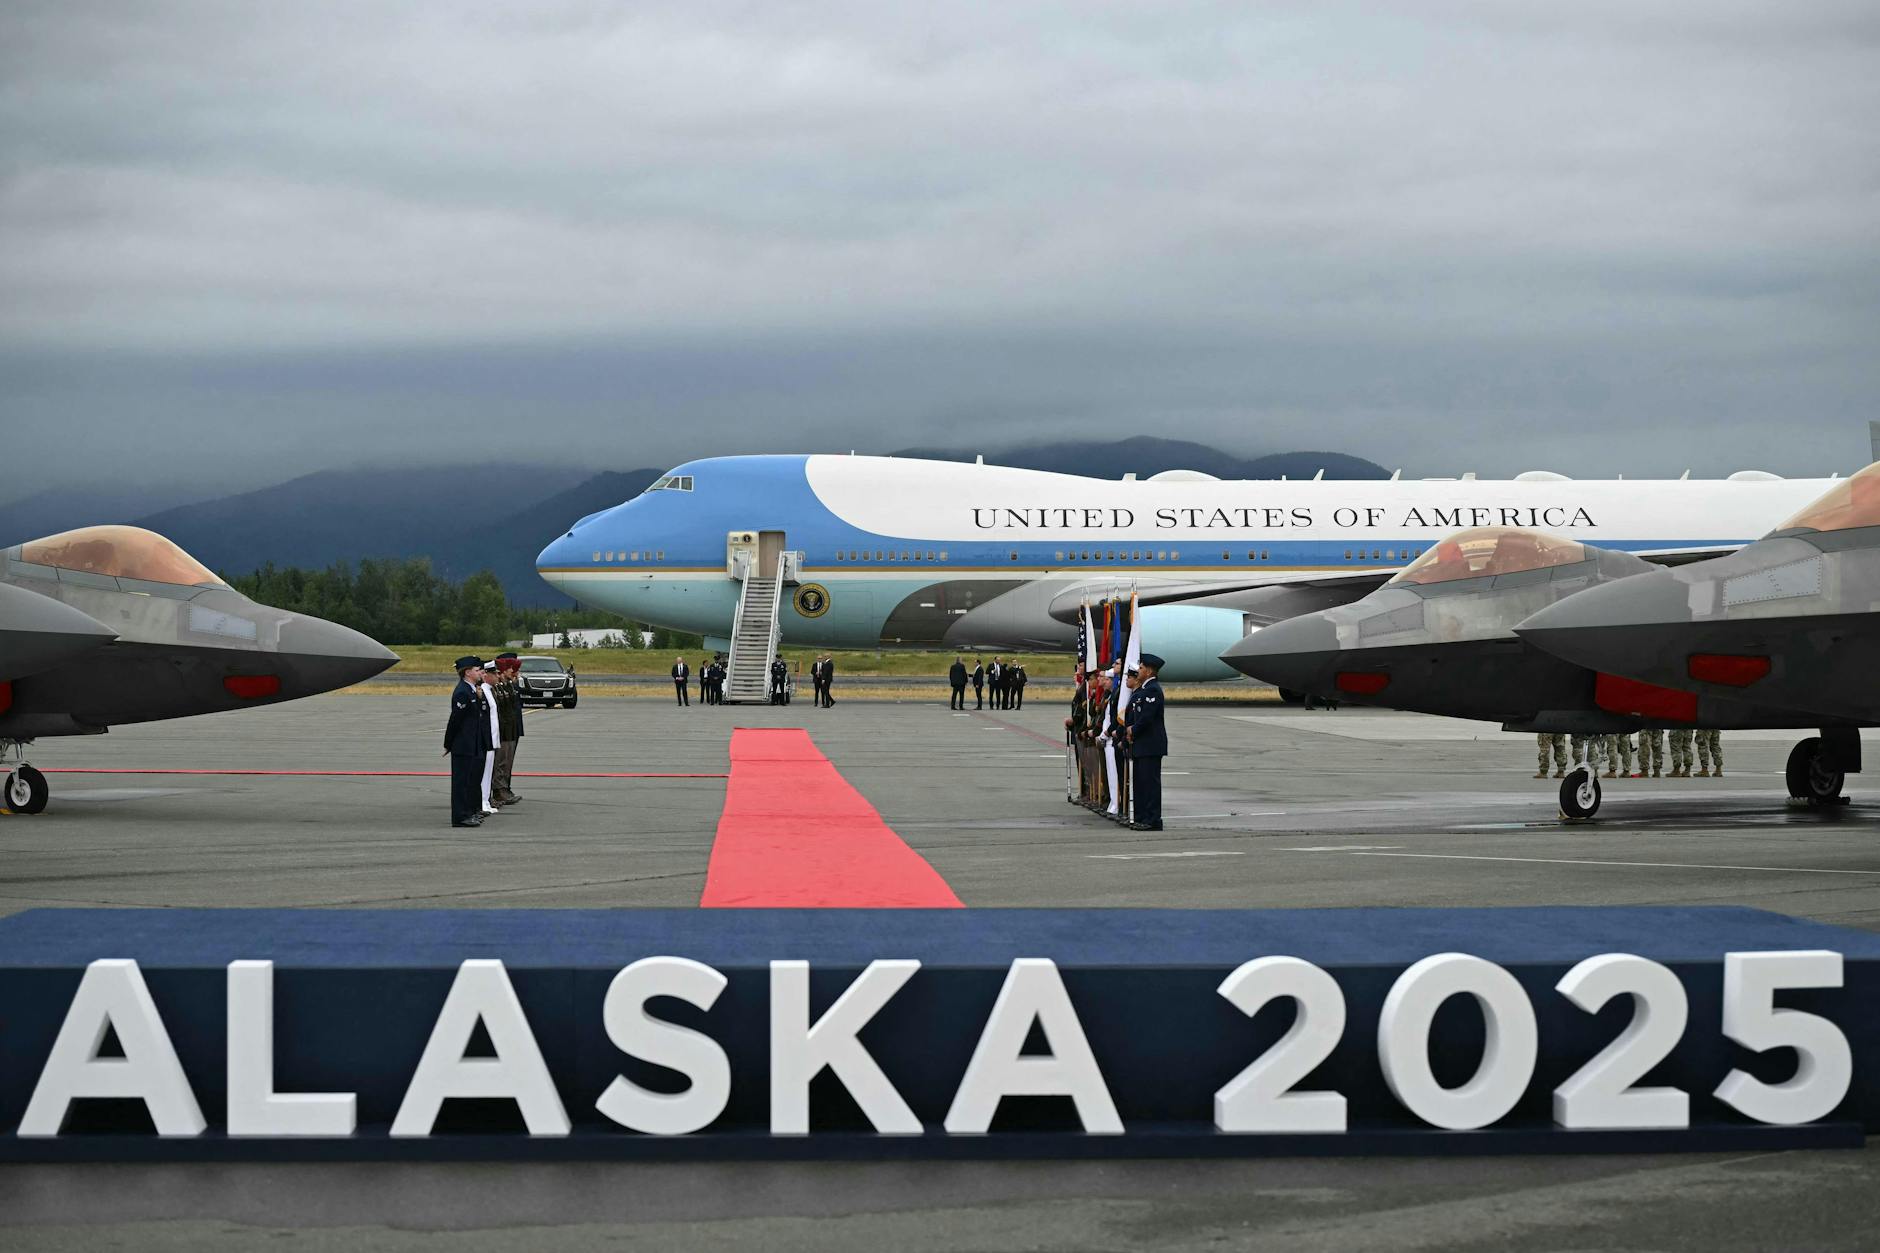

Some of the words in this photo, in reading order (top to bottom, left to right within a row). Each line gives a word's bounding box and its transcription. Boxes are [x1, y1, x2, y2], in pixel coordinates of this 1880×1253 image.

[971, 508, 1134, 528] UNITED
[1155, 508, 1313, 528] STATES
[1334, 508, 1386, 528] OF
[1401, 508, 1598, 527] AMERICA
[17, 956, 1126, 1137] ALASKA
[1214, 949, 1852, 1133] 2025
